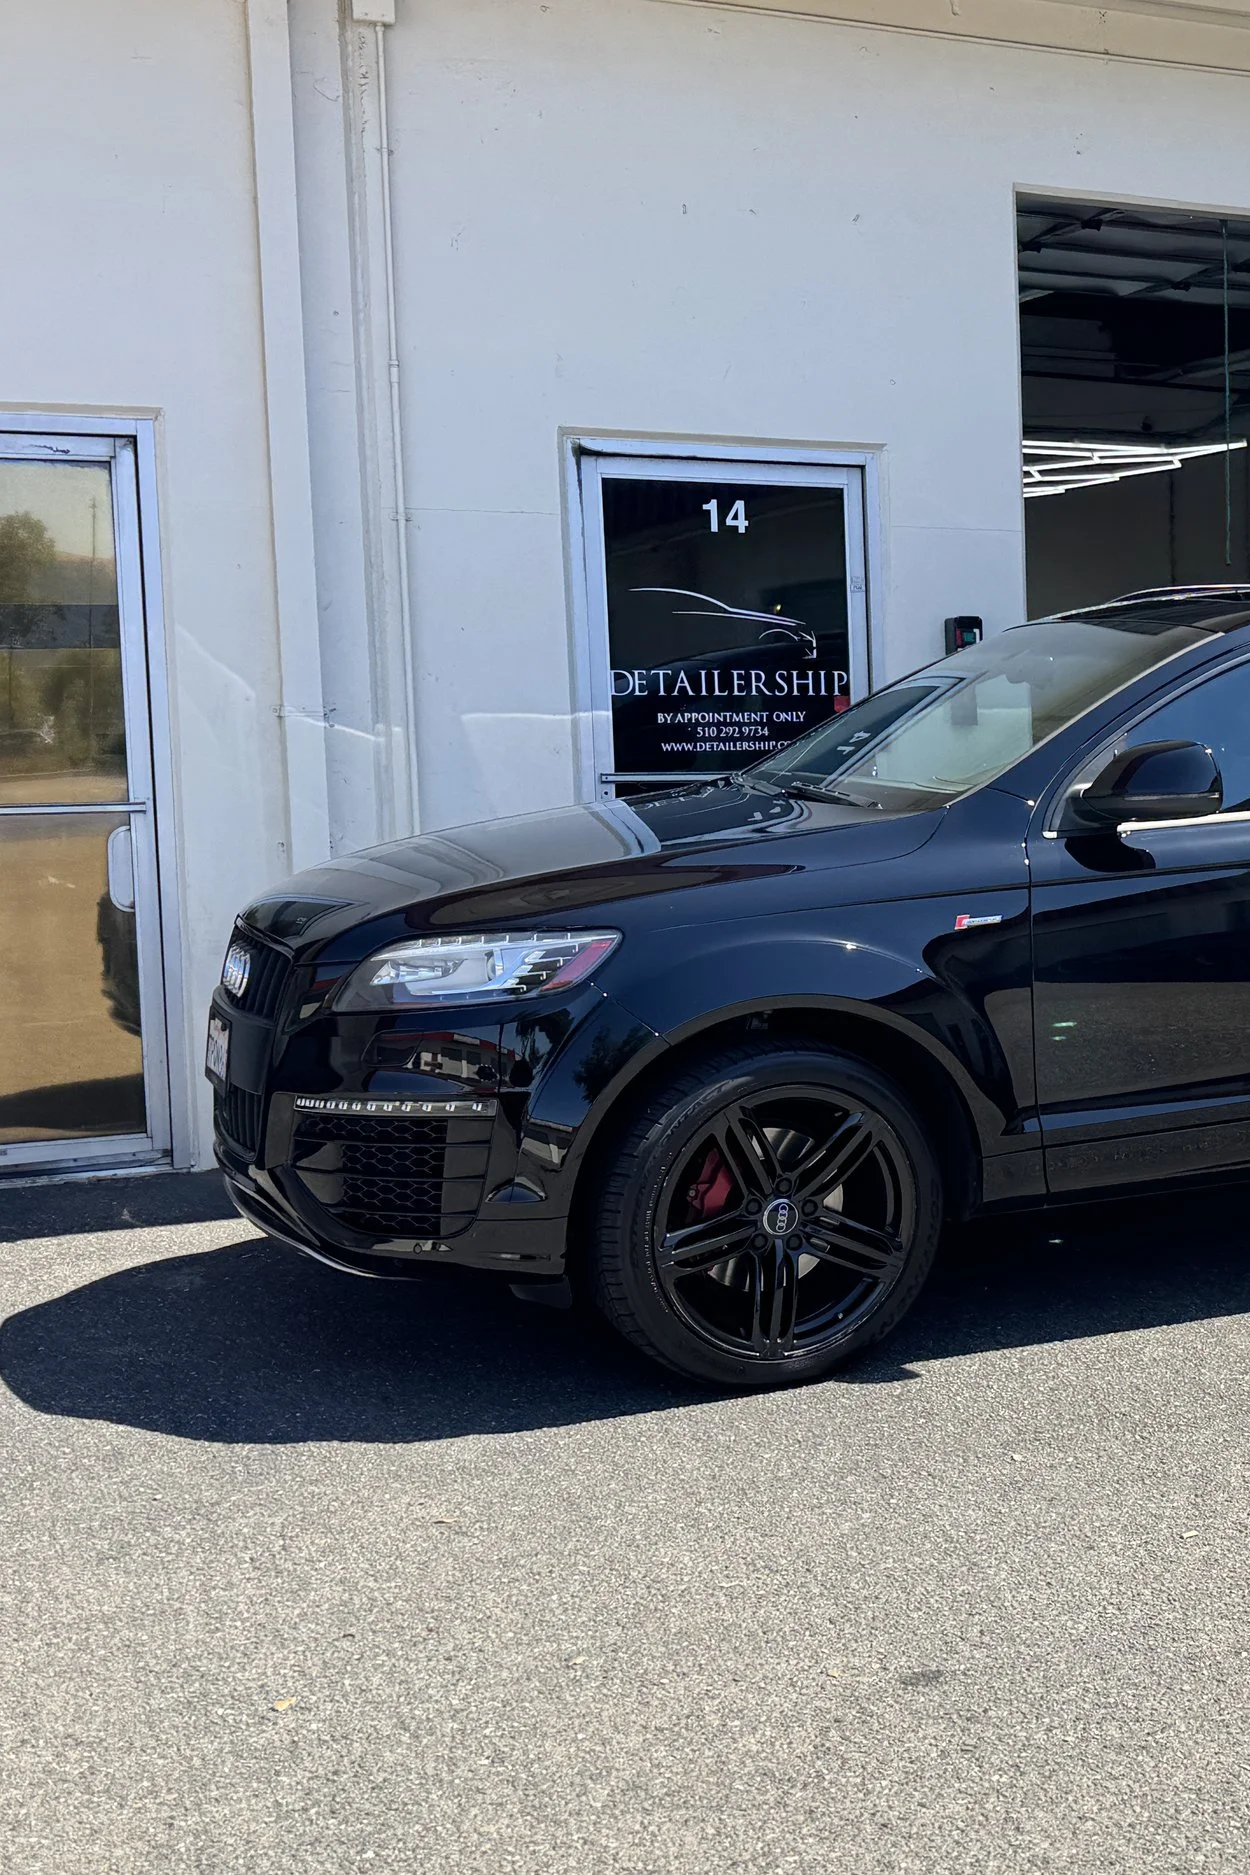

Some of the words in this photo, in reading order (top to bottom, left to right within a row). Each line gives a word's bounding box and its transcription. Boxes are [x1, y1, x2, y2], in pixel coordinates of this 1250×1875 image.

[702, 499, 749, 534] 14
[610, 670, 848, 696] DETAILERSHIP
[657, 713, 673, 723] BY
[675, 712, 769, 723] APPOINTMENT
[773, 711, 806, 722] ONLY
[697, 727, 717, 737] 510
[720, 727, 740, 737] 292
[743, 726, 769, 736] 9734
